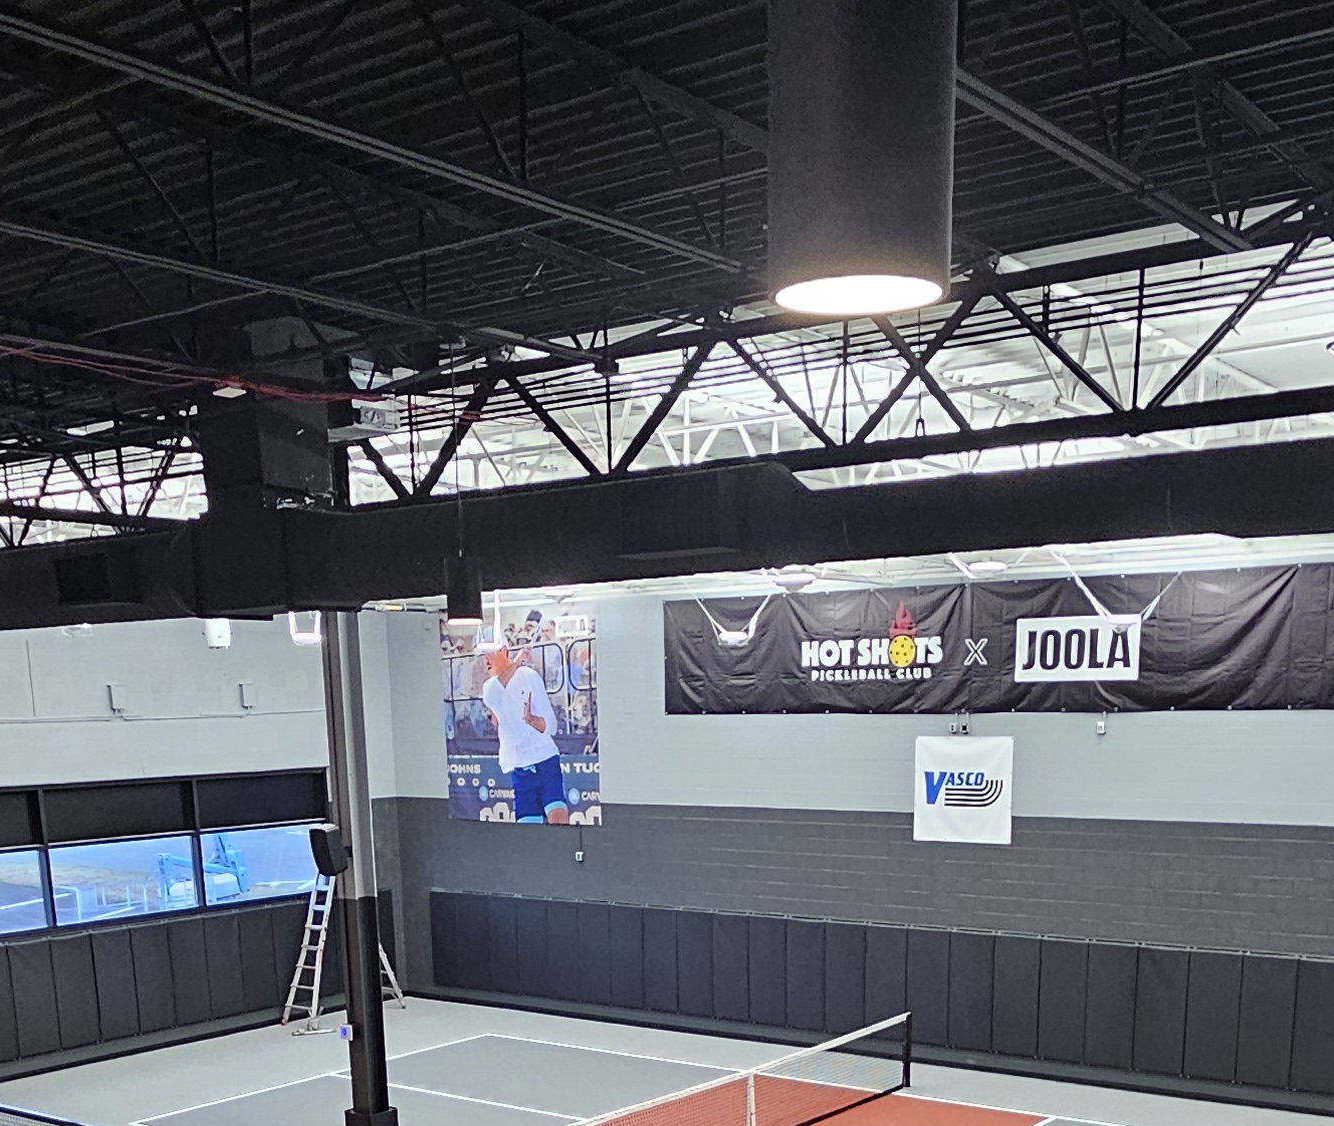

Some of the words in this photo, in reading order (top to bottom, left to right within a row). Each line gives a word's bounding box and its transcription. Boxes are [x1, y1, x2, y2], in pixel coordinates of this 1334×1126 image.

[801, 639, 855, 667] HOT
[857, 635, 943, 668] SHOTS
[1021, 626, 1132, 671] JOOLA
[811, 668, 891, 682] PICKLEBALL
[896, 667, 932, 679] CLUB
[923, 771, 985, 805] VASCO
